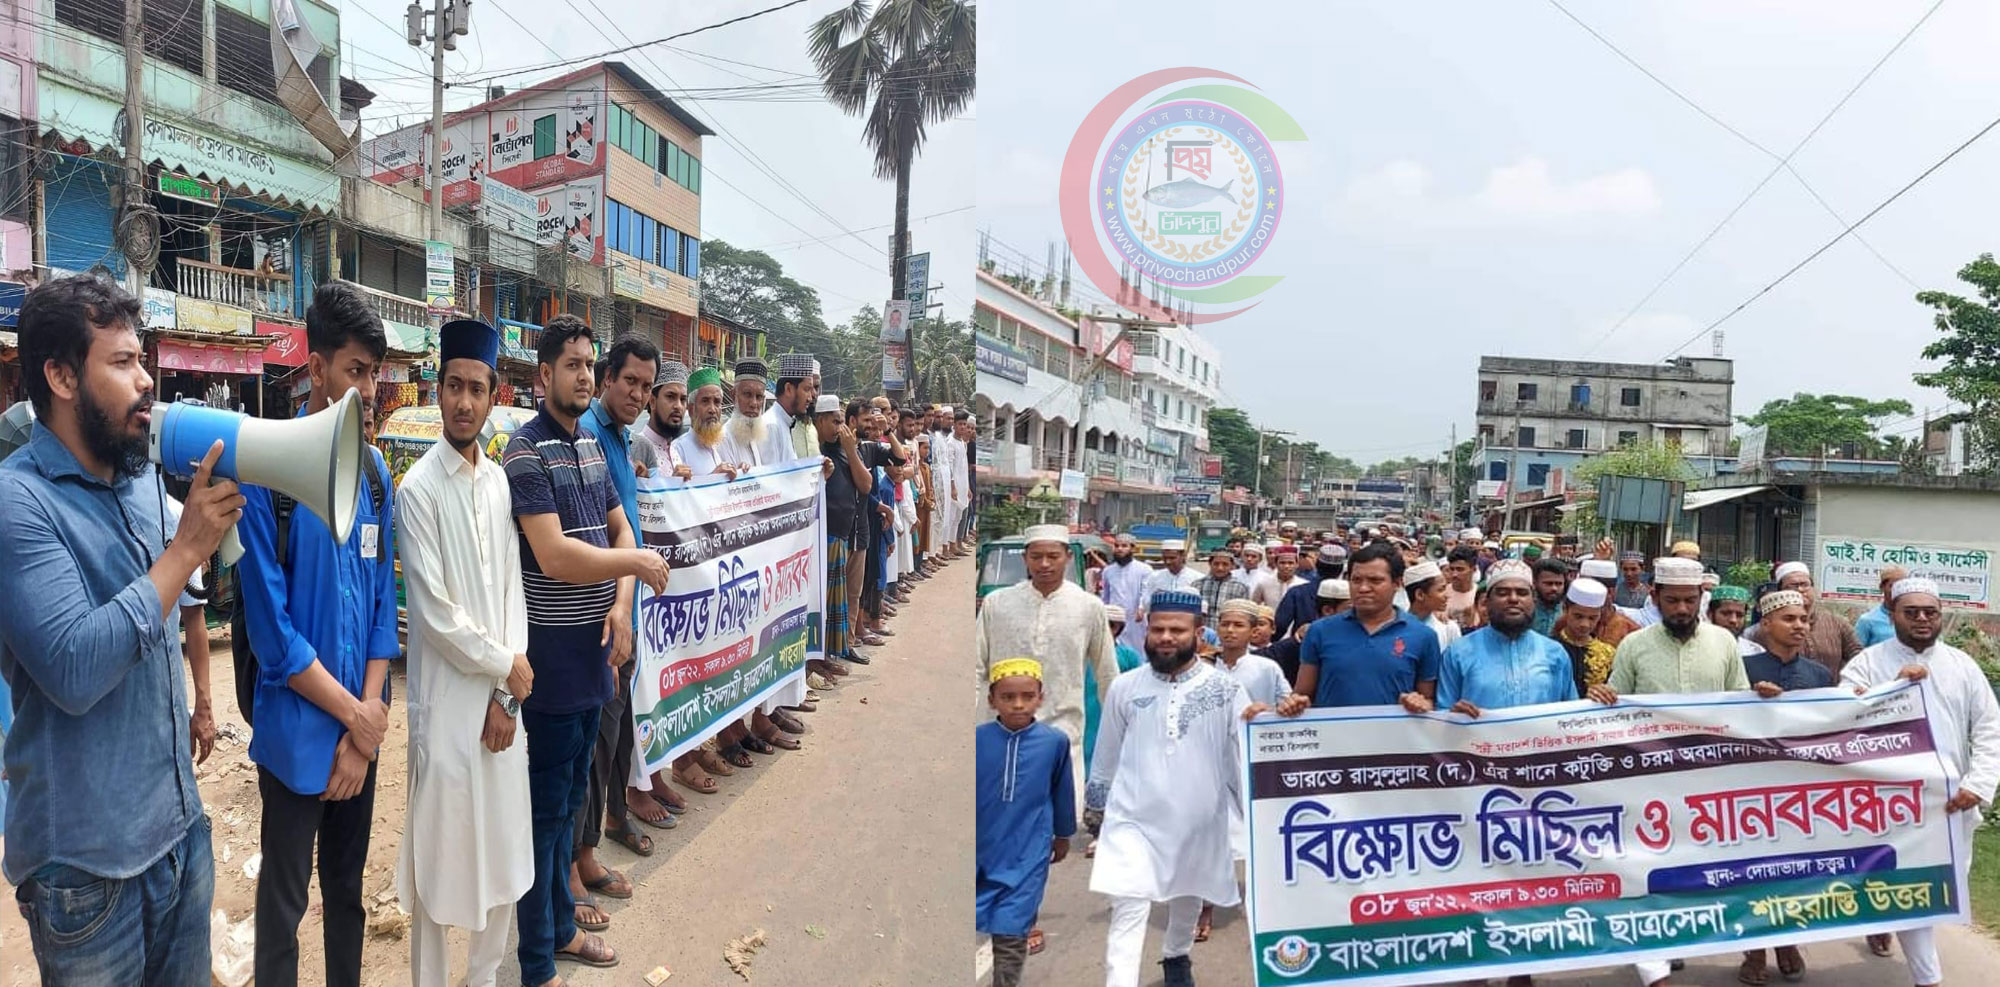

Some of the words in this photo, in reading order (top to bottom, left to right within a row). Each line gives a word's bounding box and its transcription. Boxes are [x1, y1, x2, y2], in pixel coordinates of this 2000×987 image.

[205, 137, 235, 162] সুপার
[441, 153, 466, 171] ROCEM
[535, 165, 566, 179] STANDARD
[543, 157, 565, 169] GLOBAL
[537, 215, 565, 232] ROCEM
[1882, 545, 1932, 564] হোমিও
[1937, 550, 1989, 570] ফার্মেসী
[714, 556, 760, 633] মিছিল
[763, 565, 772, 612] ও
[775, 546, 813, 603] মানবব
[662, 668, 676, 690] ০৮
[655, 693, 702, 749] বাংলাদেশ
[703, 669, 743, 716] ইসলামী
[1280, 769, 1344, 789] ভারতে
[1436, 760, 1475, 786] (দ.)
[1513, 762, 1558, 782] শানে
[1561, 752, 1615, 782] কটূক্তি
[1619, 755, 1635, 769] ও
[1640, 748, 1674, 768] চরম
[1845, 731, 1913, 757] প্রতিবাদে
[1279, 799, 1462, 882] বিক্ষোভ
[1475, 788, 1625, 871] মিছিল
[1635, 800, 1671, 850] ও
[1684, 779, 1925, 843] মানববন্ধন
[1814, 856, 1846, 874] চত্বর
[1359, 895, 1399, 917] ০৮
[1469, 887, 1513, 906] সকাল
[1517, 886, 1559, 901] ৯.৩০
[1563, 877, 1606, 897] মিনিট
[1326, 925, 1474, 971] বাংলাদেশ
[1483, 907, 1597, 957] ইসলামী
[1864, 880, 1933, 912] উত্তর
